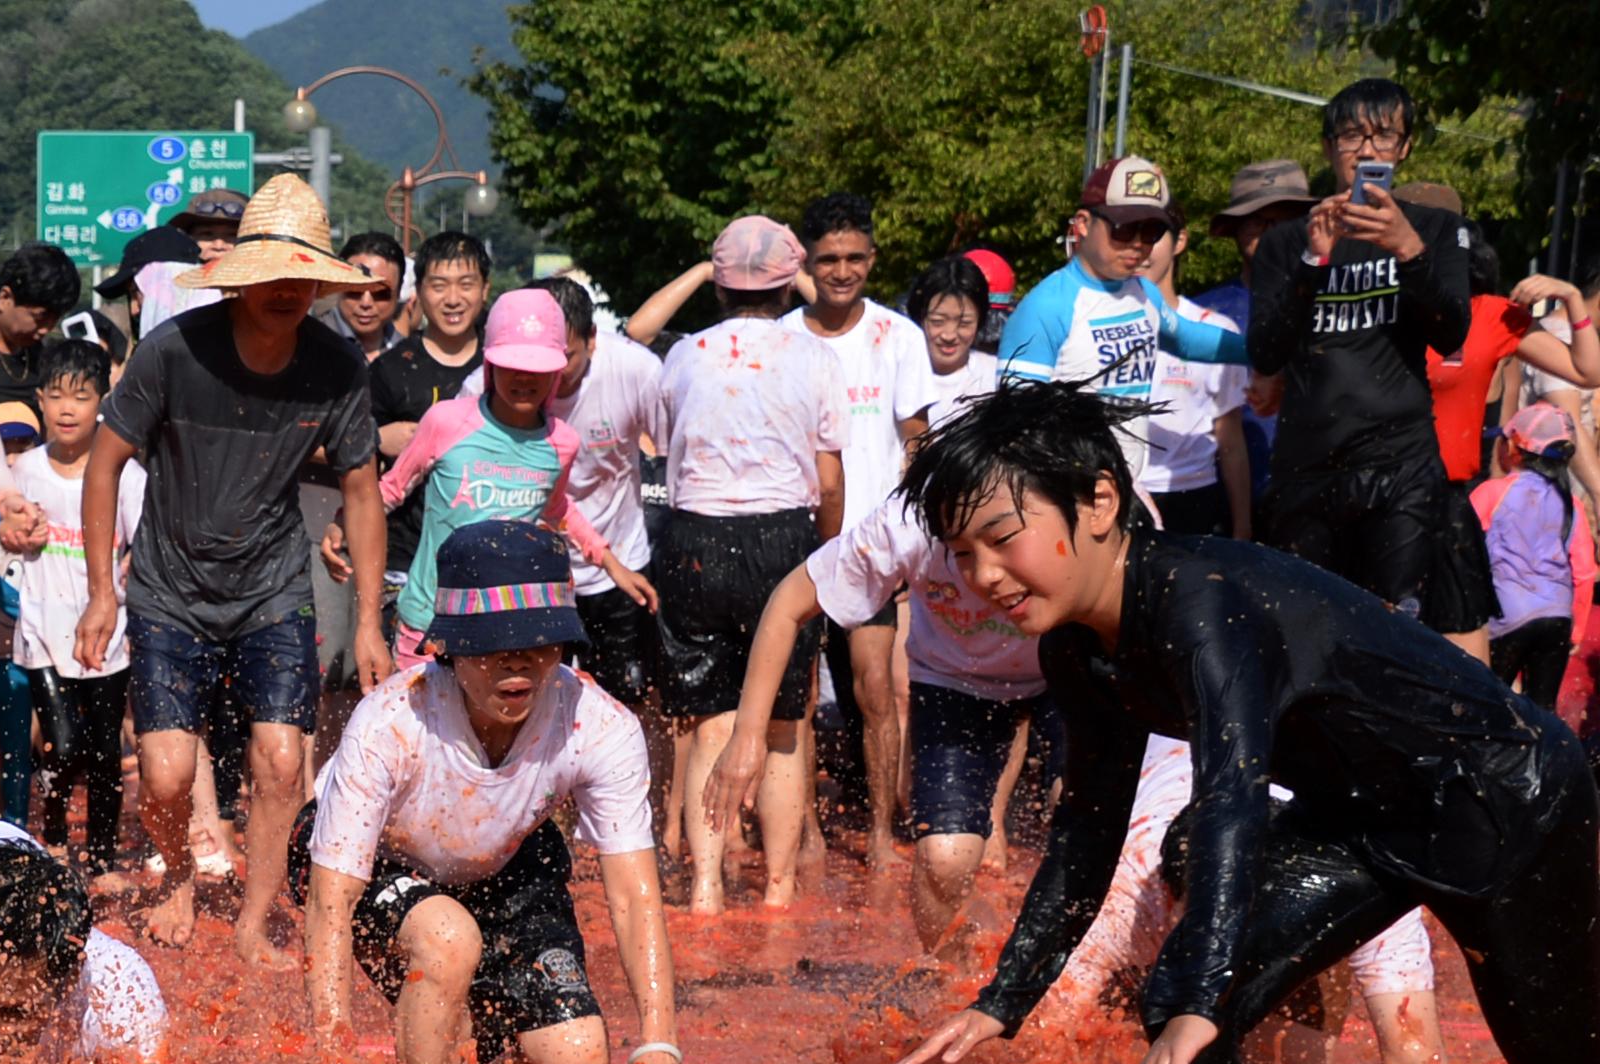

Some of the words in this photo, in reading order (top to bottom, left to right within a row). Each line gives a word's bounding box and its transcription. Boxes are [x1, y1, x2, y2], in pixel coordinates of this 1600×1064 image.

[161, 141, 173, 158] 5
[116, 211, 138, 228] 56
[1316, 256, 1400, 294] AZYBEE
[1092, 319, 1154, 342] REBELS
[1097, 335, 1157, 364] SURF
